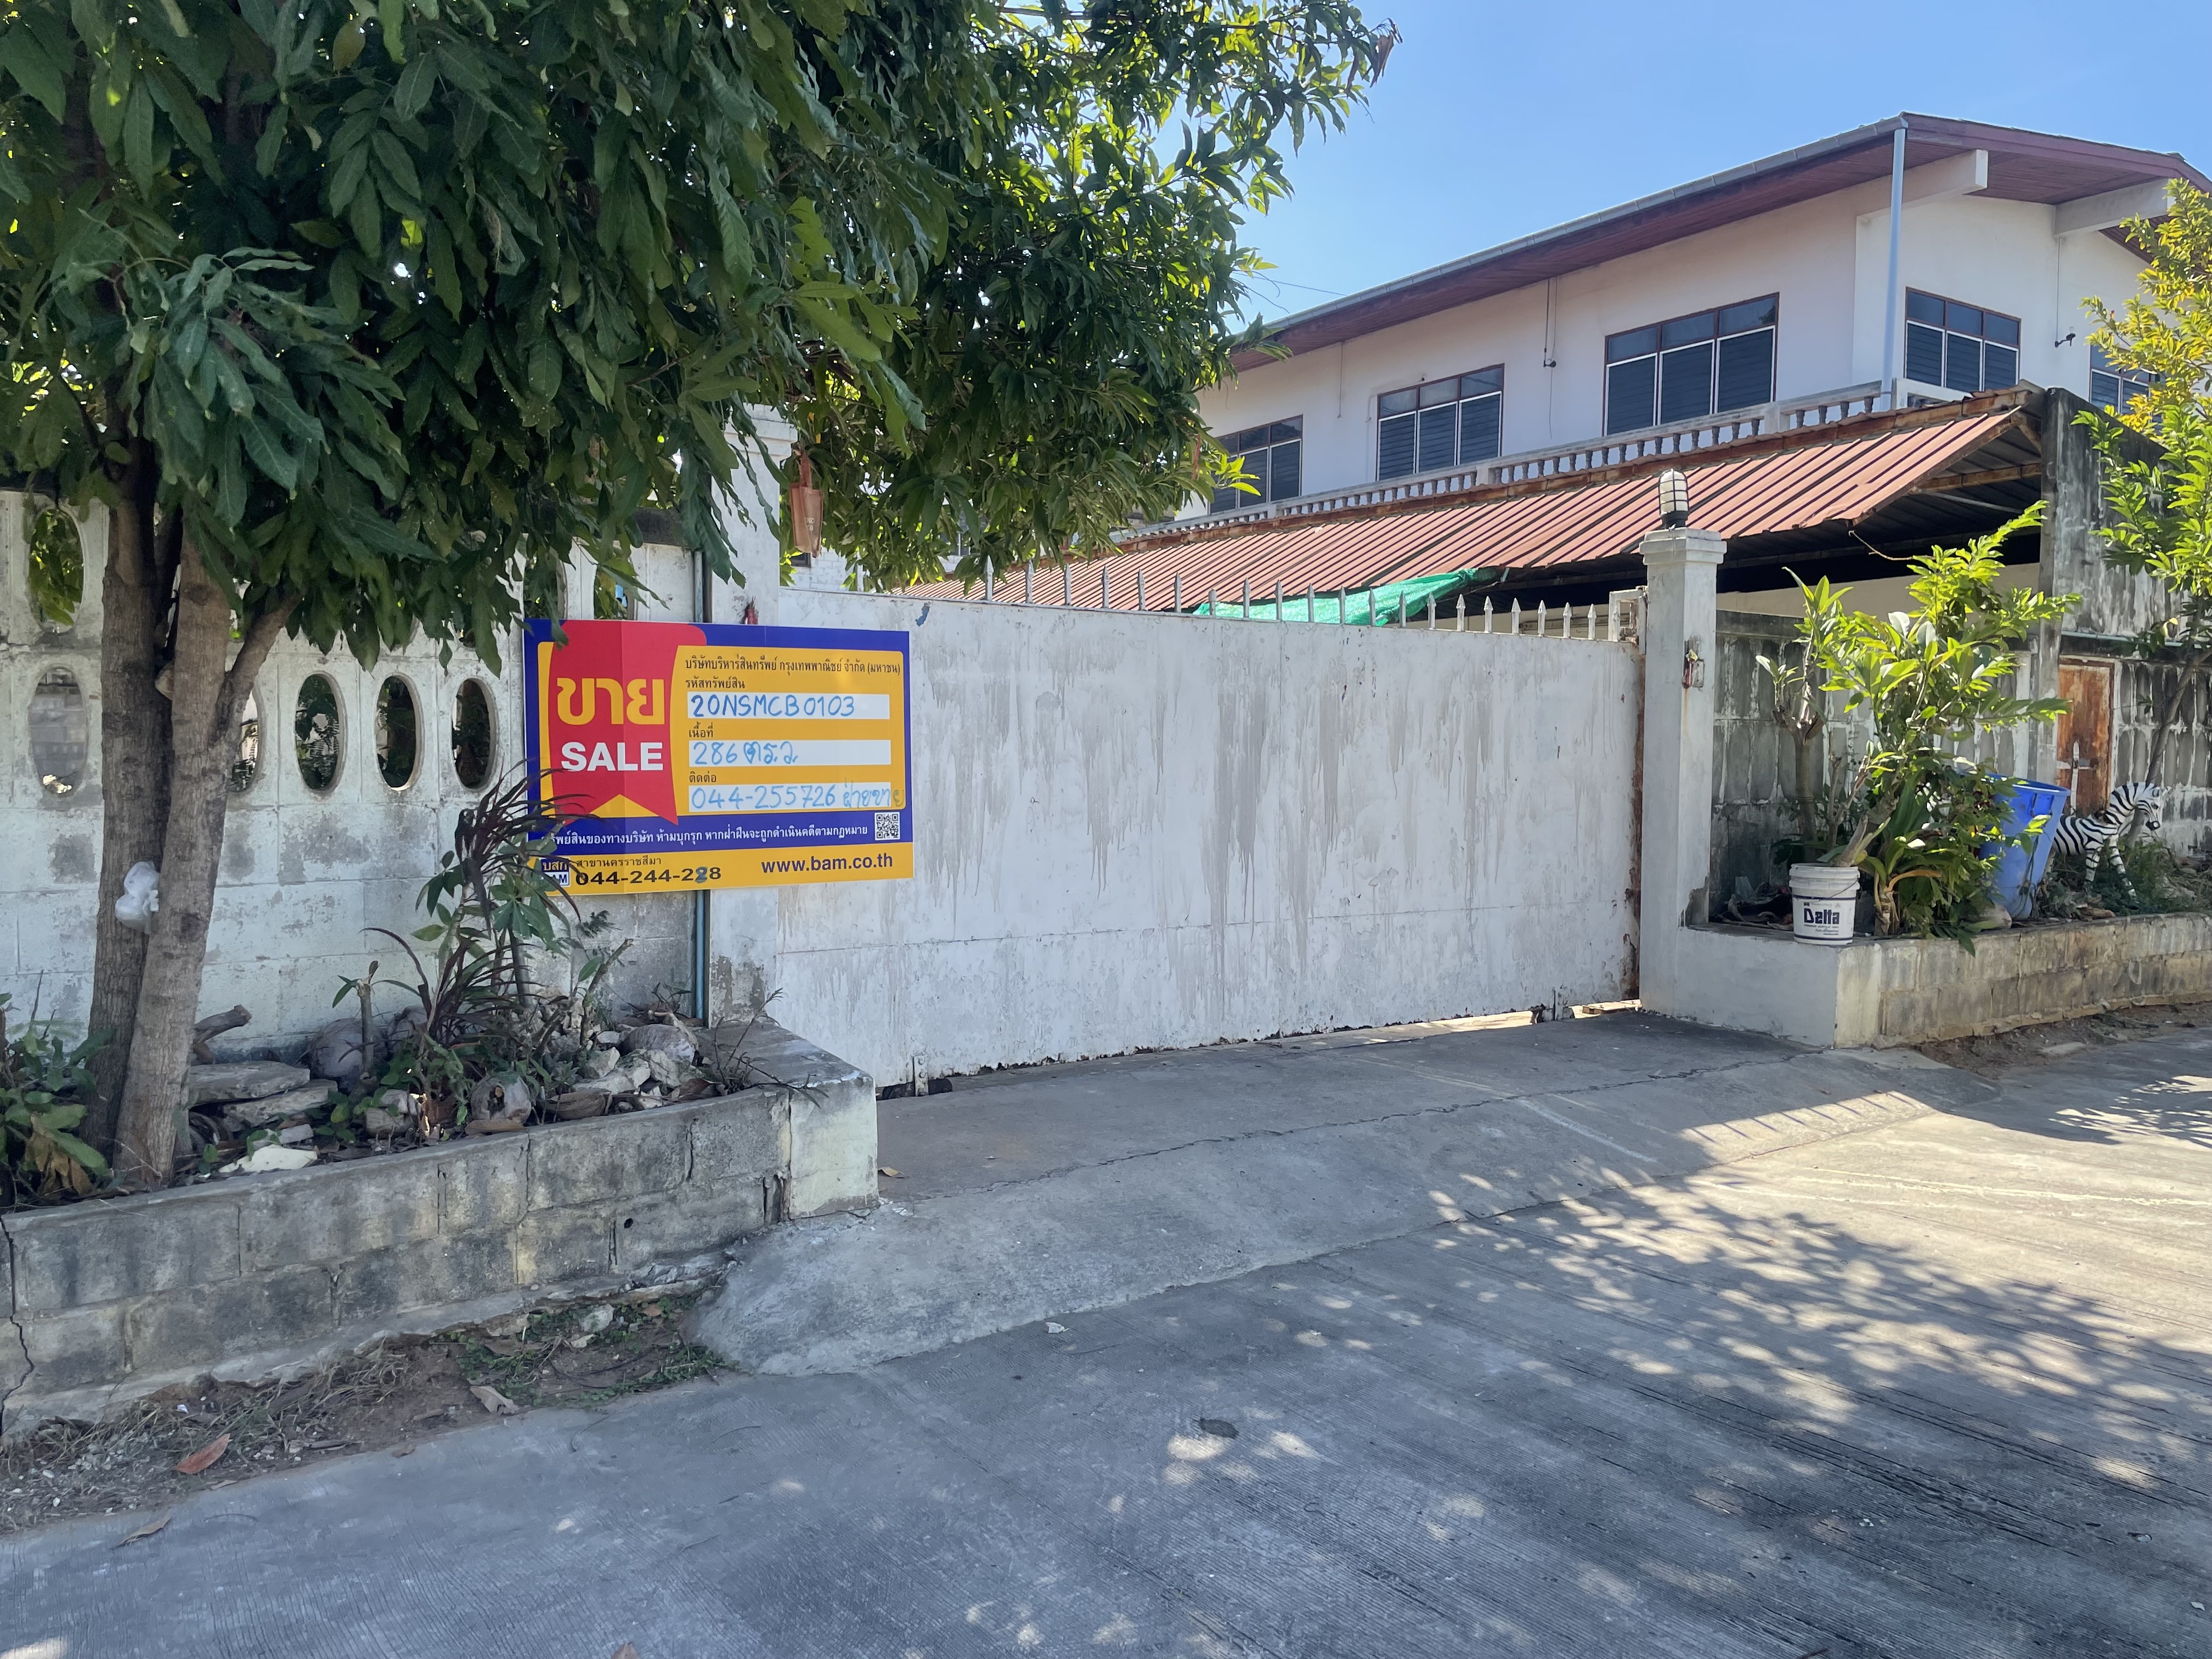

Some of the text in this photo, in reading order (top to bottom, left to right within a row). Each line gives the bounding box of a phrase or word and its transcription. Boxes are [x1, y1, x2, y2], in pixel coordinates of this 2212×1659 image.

[779, 658, 843, 676] กรุงเทพพาณิชย์
[844, 658, 865, 673] จำกัด
[867, 662, 900, 676] (มหาชน)
[685, 675, 746, 689] รหัสทรัพย์สิน
[557, 678, 665, 725] ขาย
[689, 721, 713, 738] เนื้อที่
[561, 742, 663, 771] SALE
[693, 741, 738, 765] 286
[689, 771, 717, 783] ติดต่อ
[692, 784, 836, 809] 044-255726
[541, 830, 654, 845] พย์สินของทางบริษัท
[656, 828, 703, 845] ห้ามบุกรุก
[577, 855, 662, 867] สาขานครราชสีมา
[761, 853, 893, 873] www.bam.co.th
[1804, 908, 1839, 924] Delta
